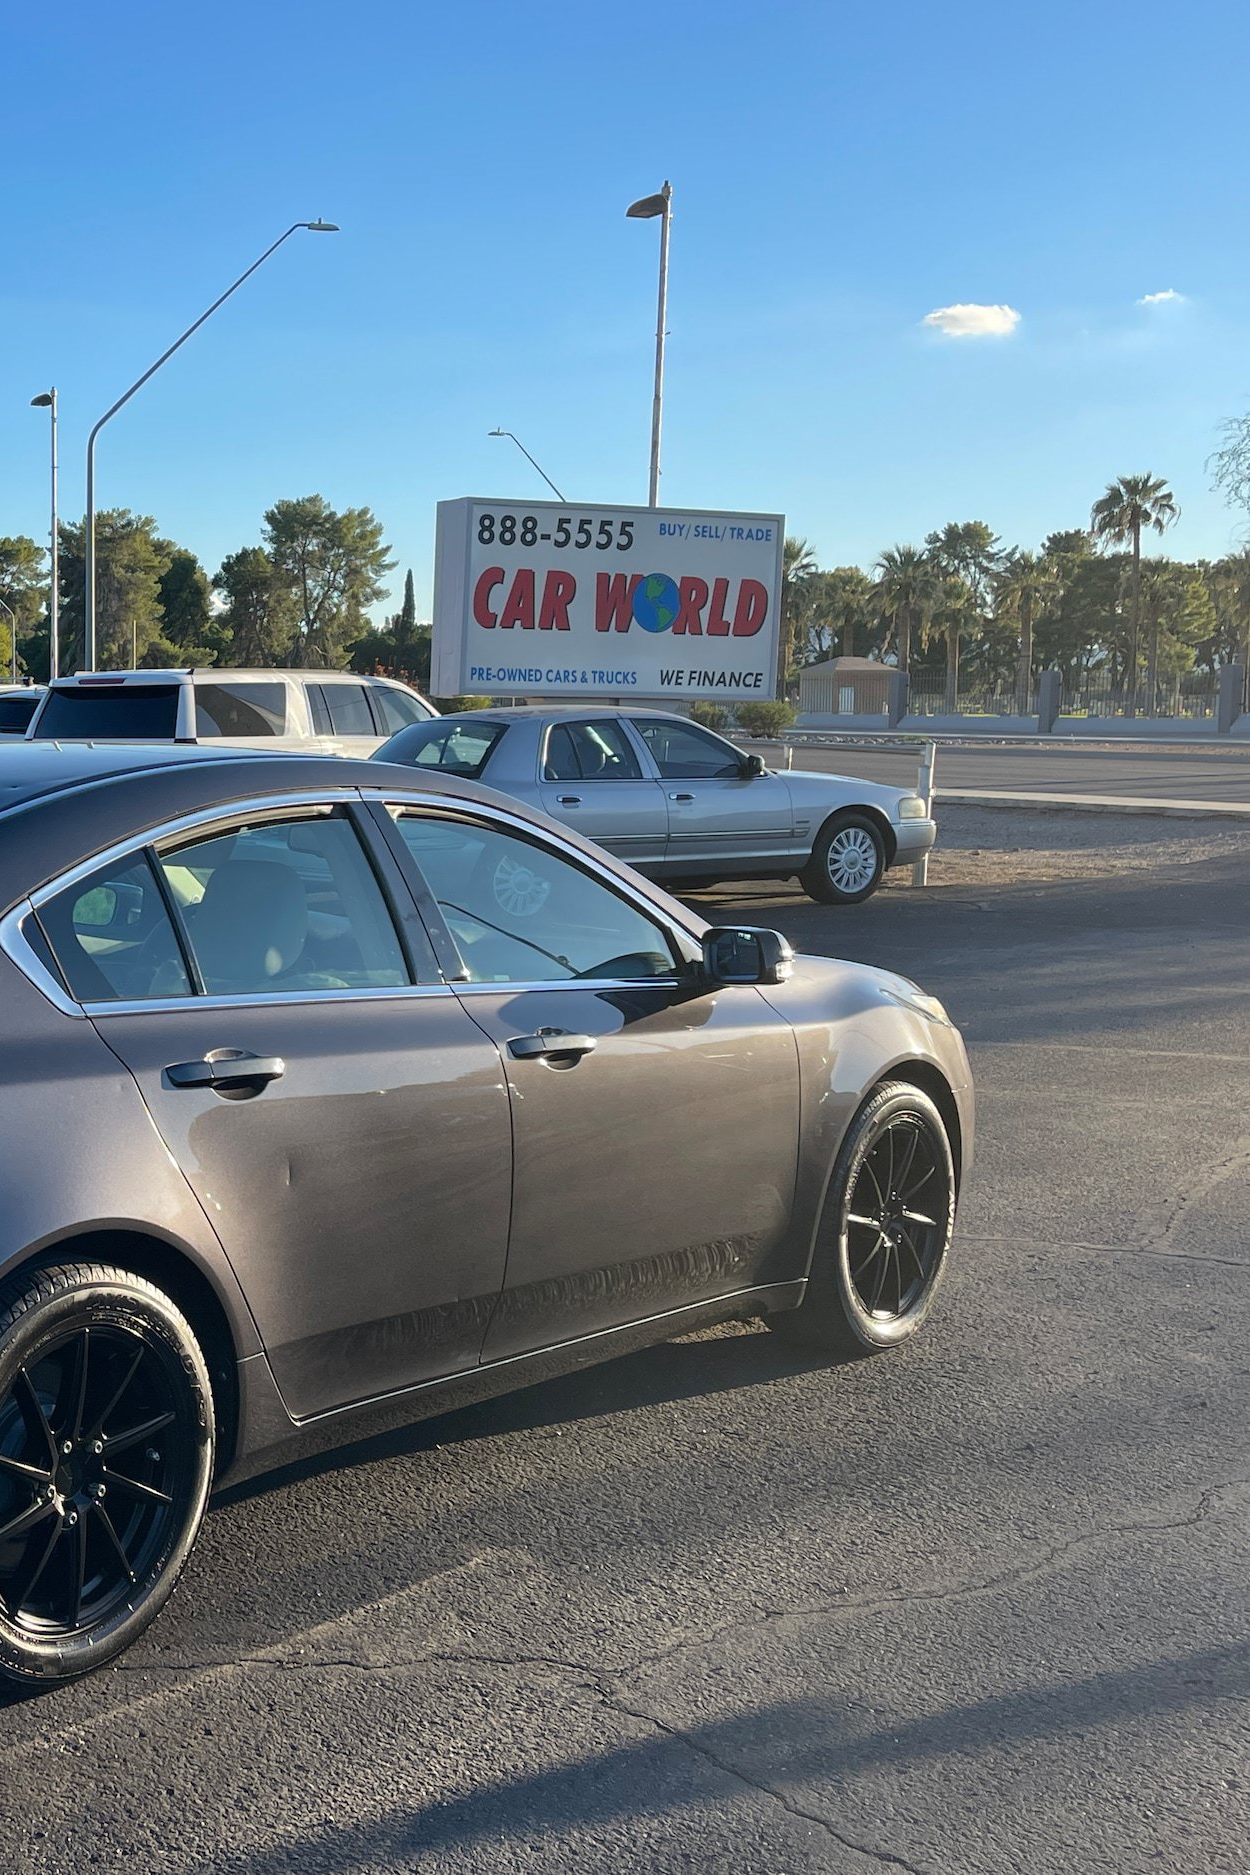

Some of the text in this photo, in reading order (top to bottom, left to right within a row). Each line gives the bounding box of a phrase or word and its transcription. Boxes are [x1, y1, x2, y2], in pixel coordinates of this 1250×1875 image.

[478, 514, 634, 551] 888-5555
[730, 527, 772, 541] TRADE
[473, 566, 768, 637] CAR WORLD
[470, 667, 637, 685] PRE-OWNED CARS & TRUCKS
[660, 669, 764, 688] WE FINANCE
